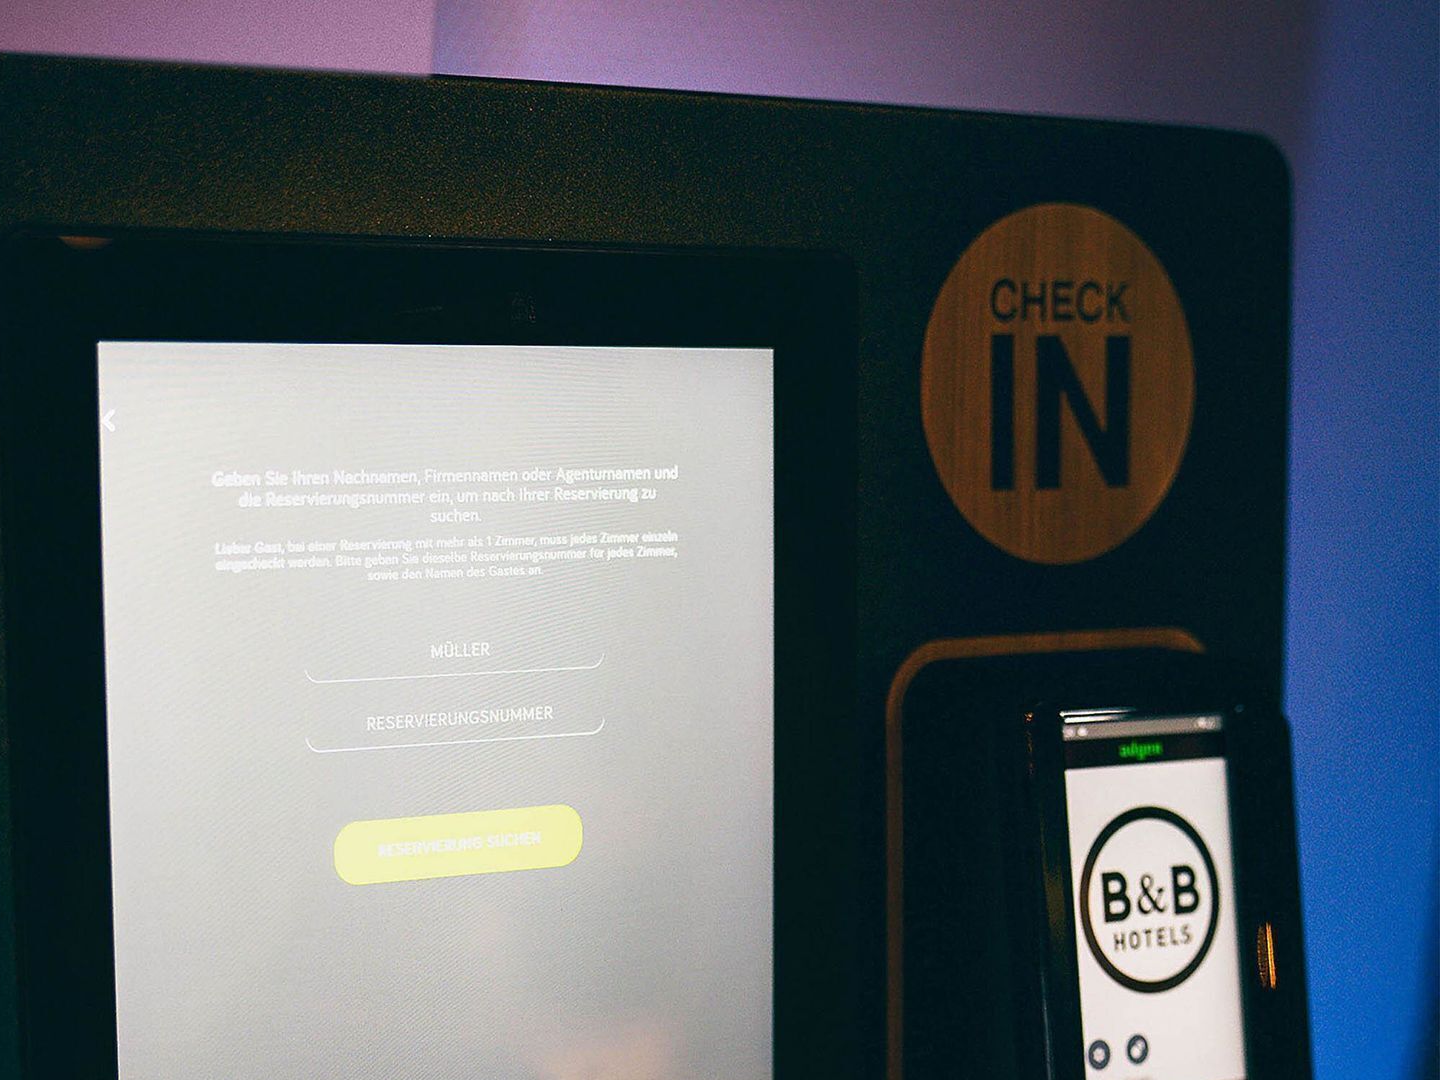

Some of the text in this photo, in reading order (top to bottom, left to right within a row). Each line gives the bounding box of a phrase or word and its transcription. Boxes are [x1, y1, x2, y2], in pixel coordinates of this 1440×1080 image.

[990, 278, 1131, 323] CHECK
[991, 333, 1131, 491] IN
[212, 464, 679, 487] Geben Sie Ihren Nachnamen, Firmennamen oder Agenturnamen und
[239, 486, 658, 509] die Reservierungsnummer ein, um nach Ihrer Reservierung zu
[430, 508, 482, 523] suchen.
[288, 541, 305, 553] bei
[340, 539, 412, 553] Reservierung
[415, 538, 434, 550] mit
[437, 537, 465, 550] mehr
[468, 536, 484, 548] als
[495, 535, 537, 549] Zimmer,
[540, 536, 567, 546] muss
[569, 532, 597, 547] jedes
[600, 532, 639, 544] Zimmer
[336, 555, 361, 567] Bitte
[364, 554, 399, 569] geben
[402, 554, 418, 565] Sie
[422, 551, 467, 565] dieselbe
[471, 548, 587, 564] Reservierungsnummer
[606, 546, 634, 561] jedes
[636, 545, 678, 559] Zimmer,
[367, 565, 544, 582] sowie den Namen des Gastes an.
[431, 641, 490, 658] MÜLLER
[367, 706, 554, 731] RESERVIERUNGSNUMMER
[1102, 865, 1200, 923] B&B
[1113, 925, 1192, 951] HOTELS
